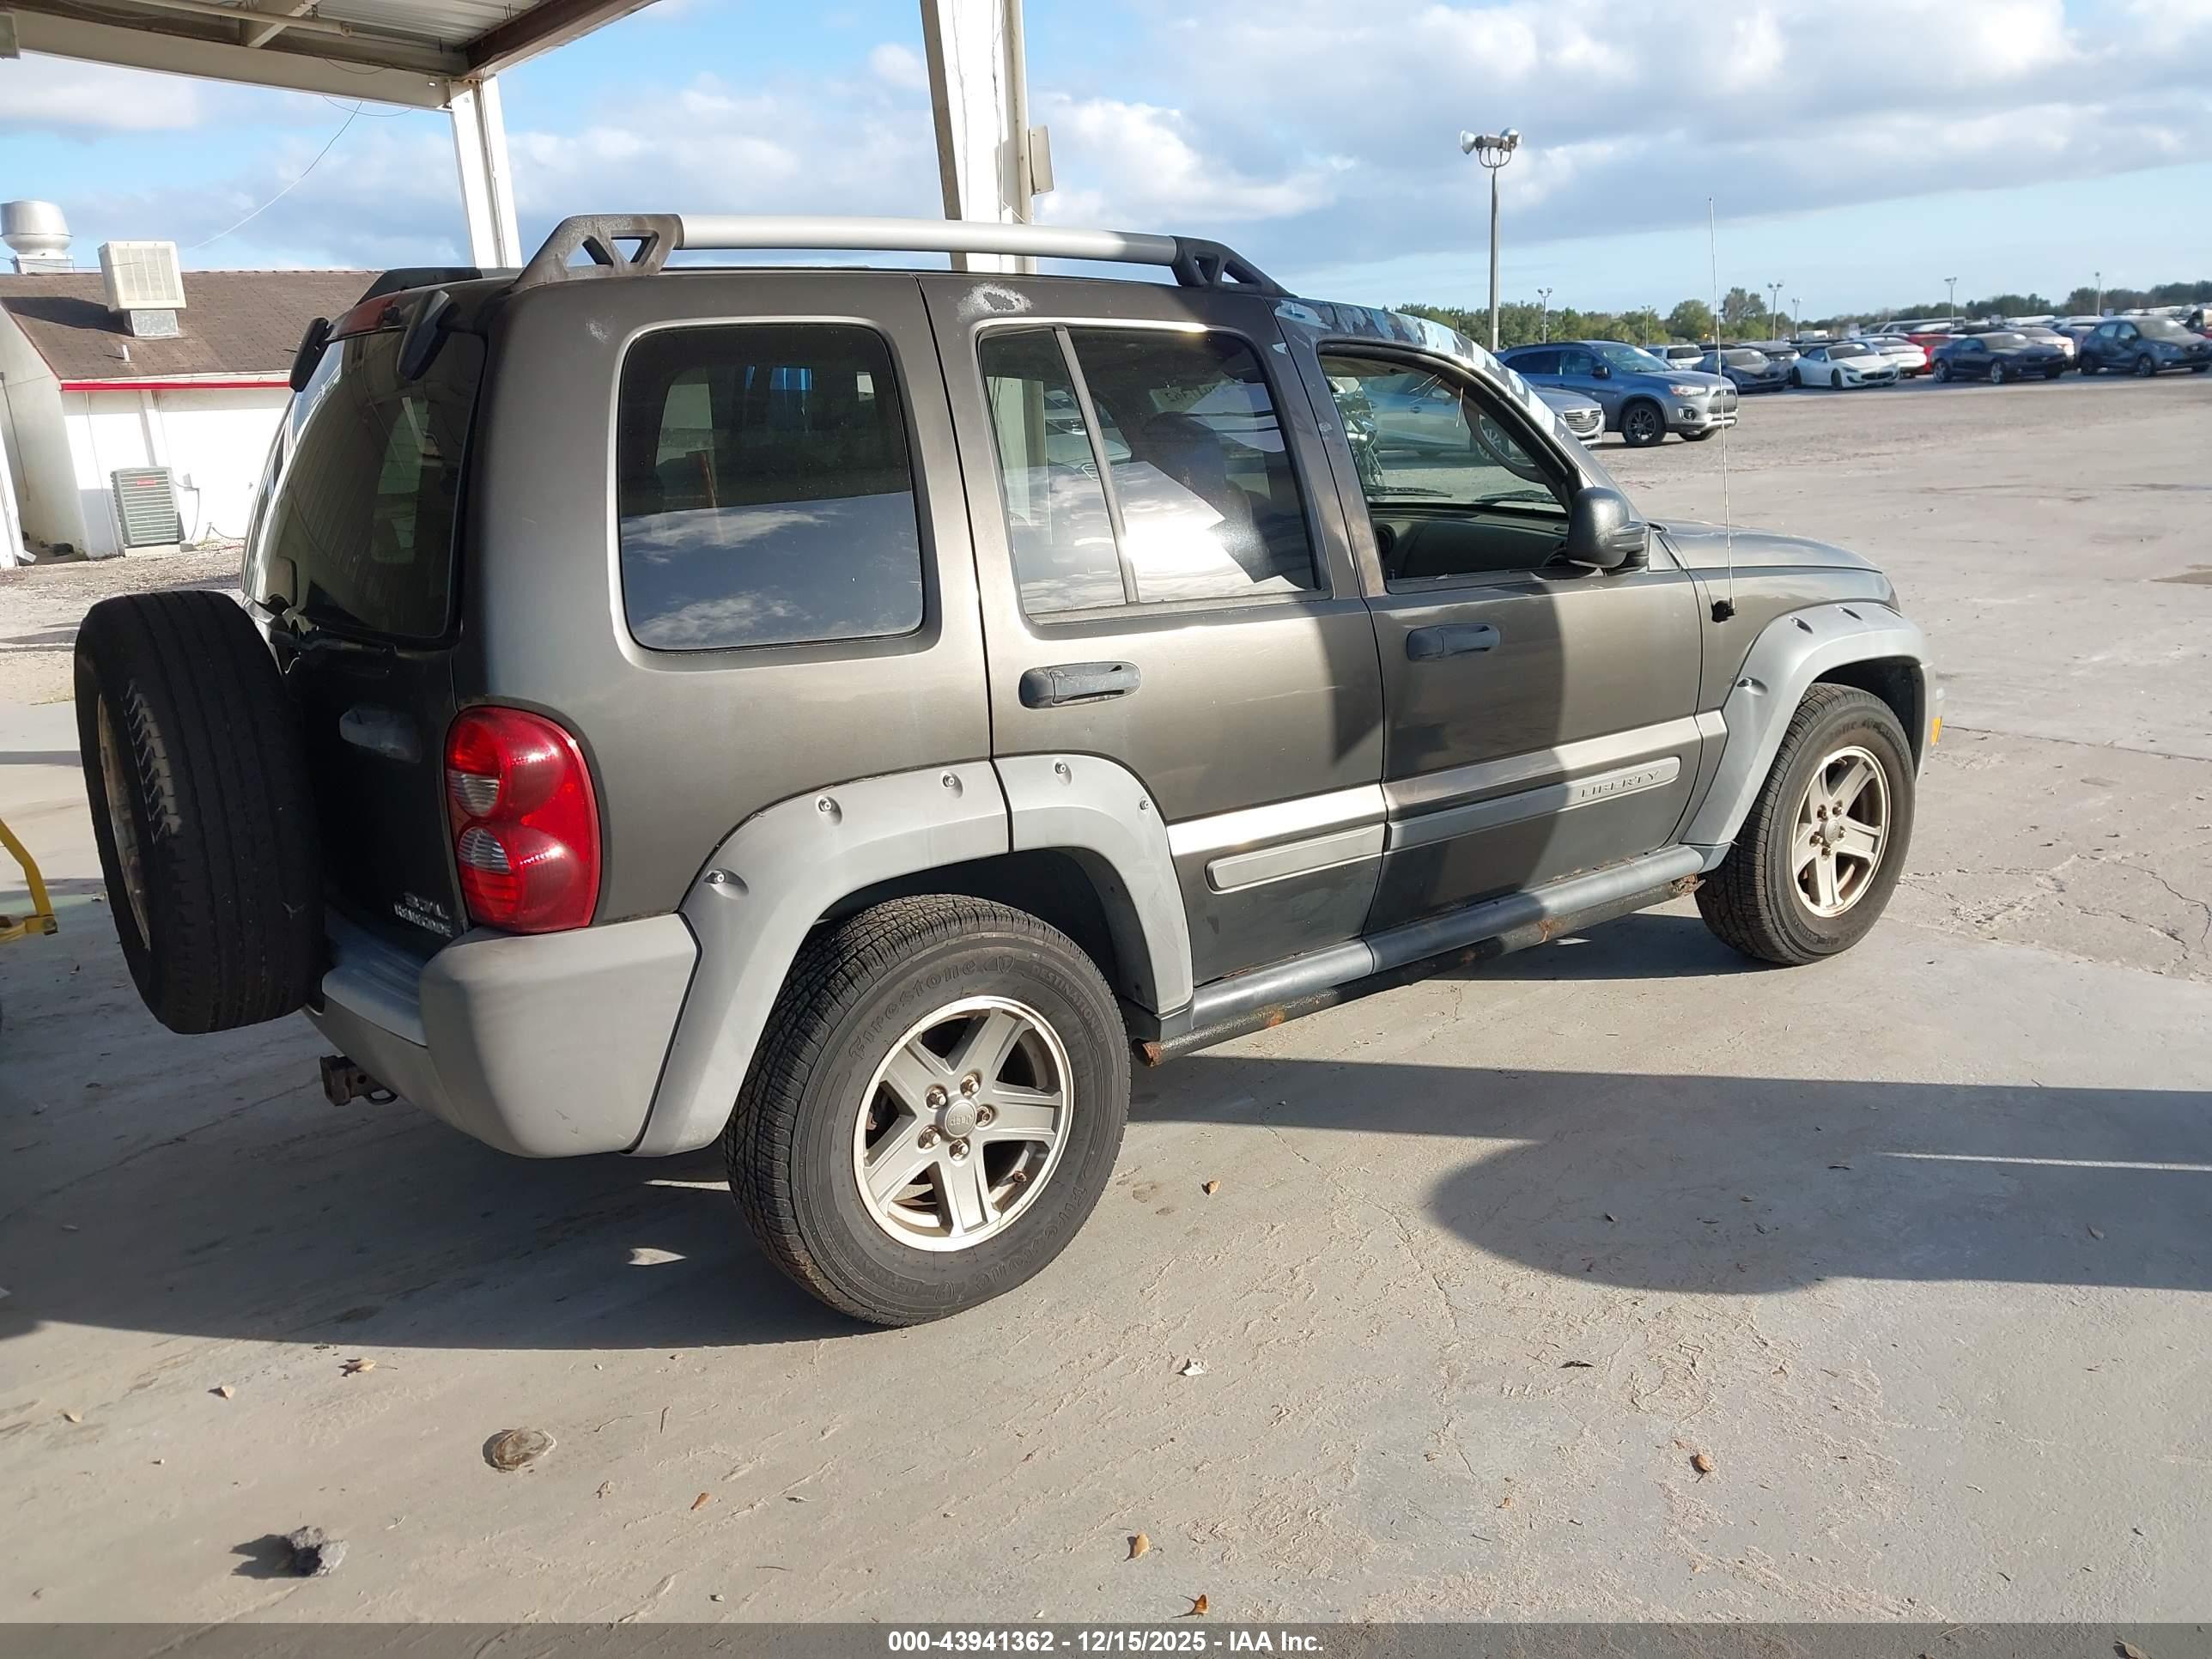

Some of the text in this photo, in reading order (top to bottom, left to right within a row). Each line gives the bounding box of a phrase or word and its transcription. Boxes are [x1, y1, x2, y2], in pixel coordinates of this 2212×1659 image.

[1581, 769, 1661, 798] LIBERTY
[848, 958, 976, 1060] Firestone
[1030, 963, 1098, 1029] DESTINATION
